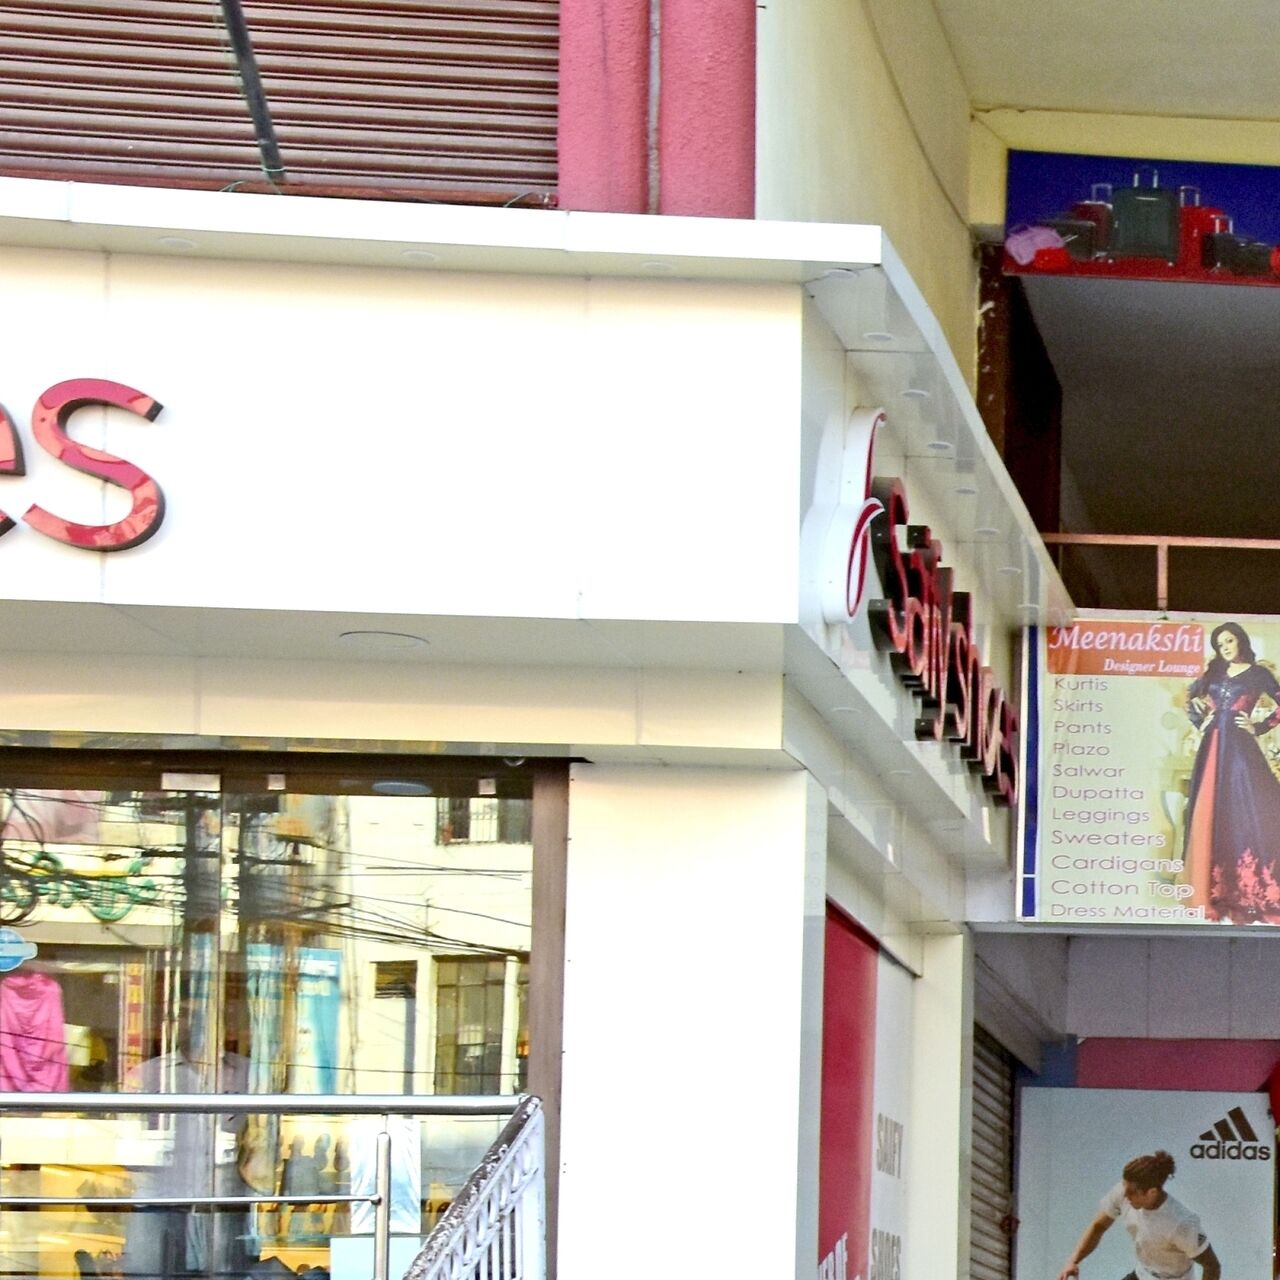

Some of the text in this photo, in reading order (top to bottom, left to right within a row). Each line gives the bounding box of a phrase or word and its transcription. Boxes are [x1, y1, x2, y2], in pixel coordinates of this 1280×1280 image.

[1049, 624, 1203, 652] Meenakshi
[1103, 657, 1201, 676] Designer Lounge
[1054, 677, 1109, 693] Kurtis
[1053, 699, 1104, 714] Skirts
[1053, 720, 1113, 735] Pants
[1053, 741, 1111, 757] Plazo
[1052, 764, 1126, 779] Salwar
[1052, 785, 1145, 804] Dupatta
[1051, 807, 1151, 824] Leggings
[1051, 830, 1166, 847] Sweaters
[1050, 855, 1185, 873] Cardigans
[1050, 879, 1194, 900] Cotton Top
[1050, 903, 1207, 920] Dress Material
[1189, 1140, 1271, 1161] adidas
